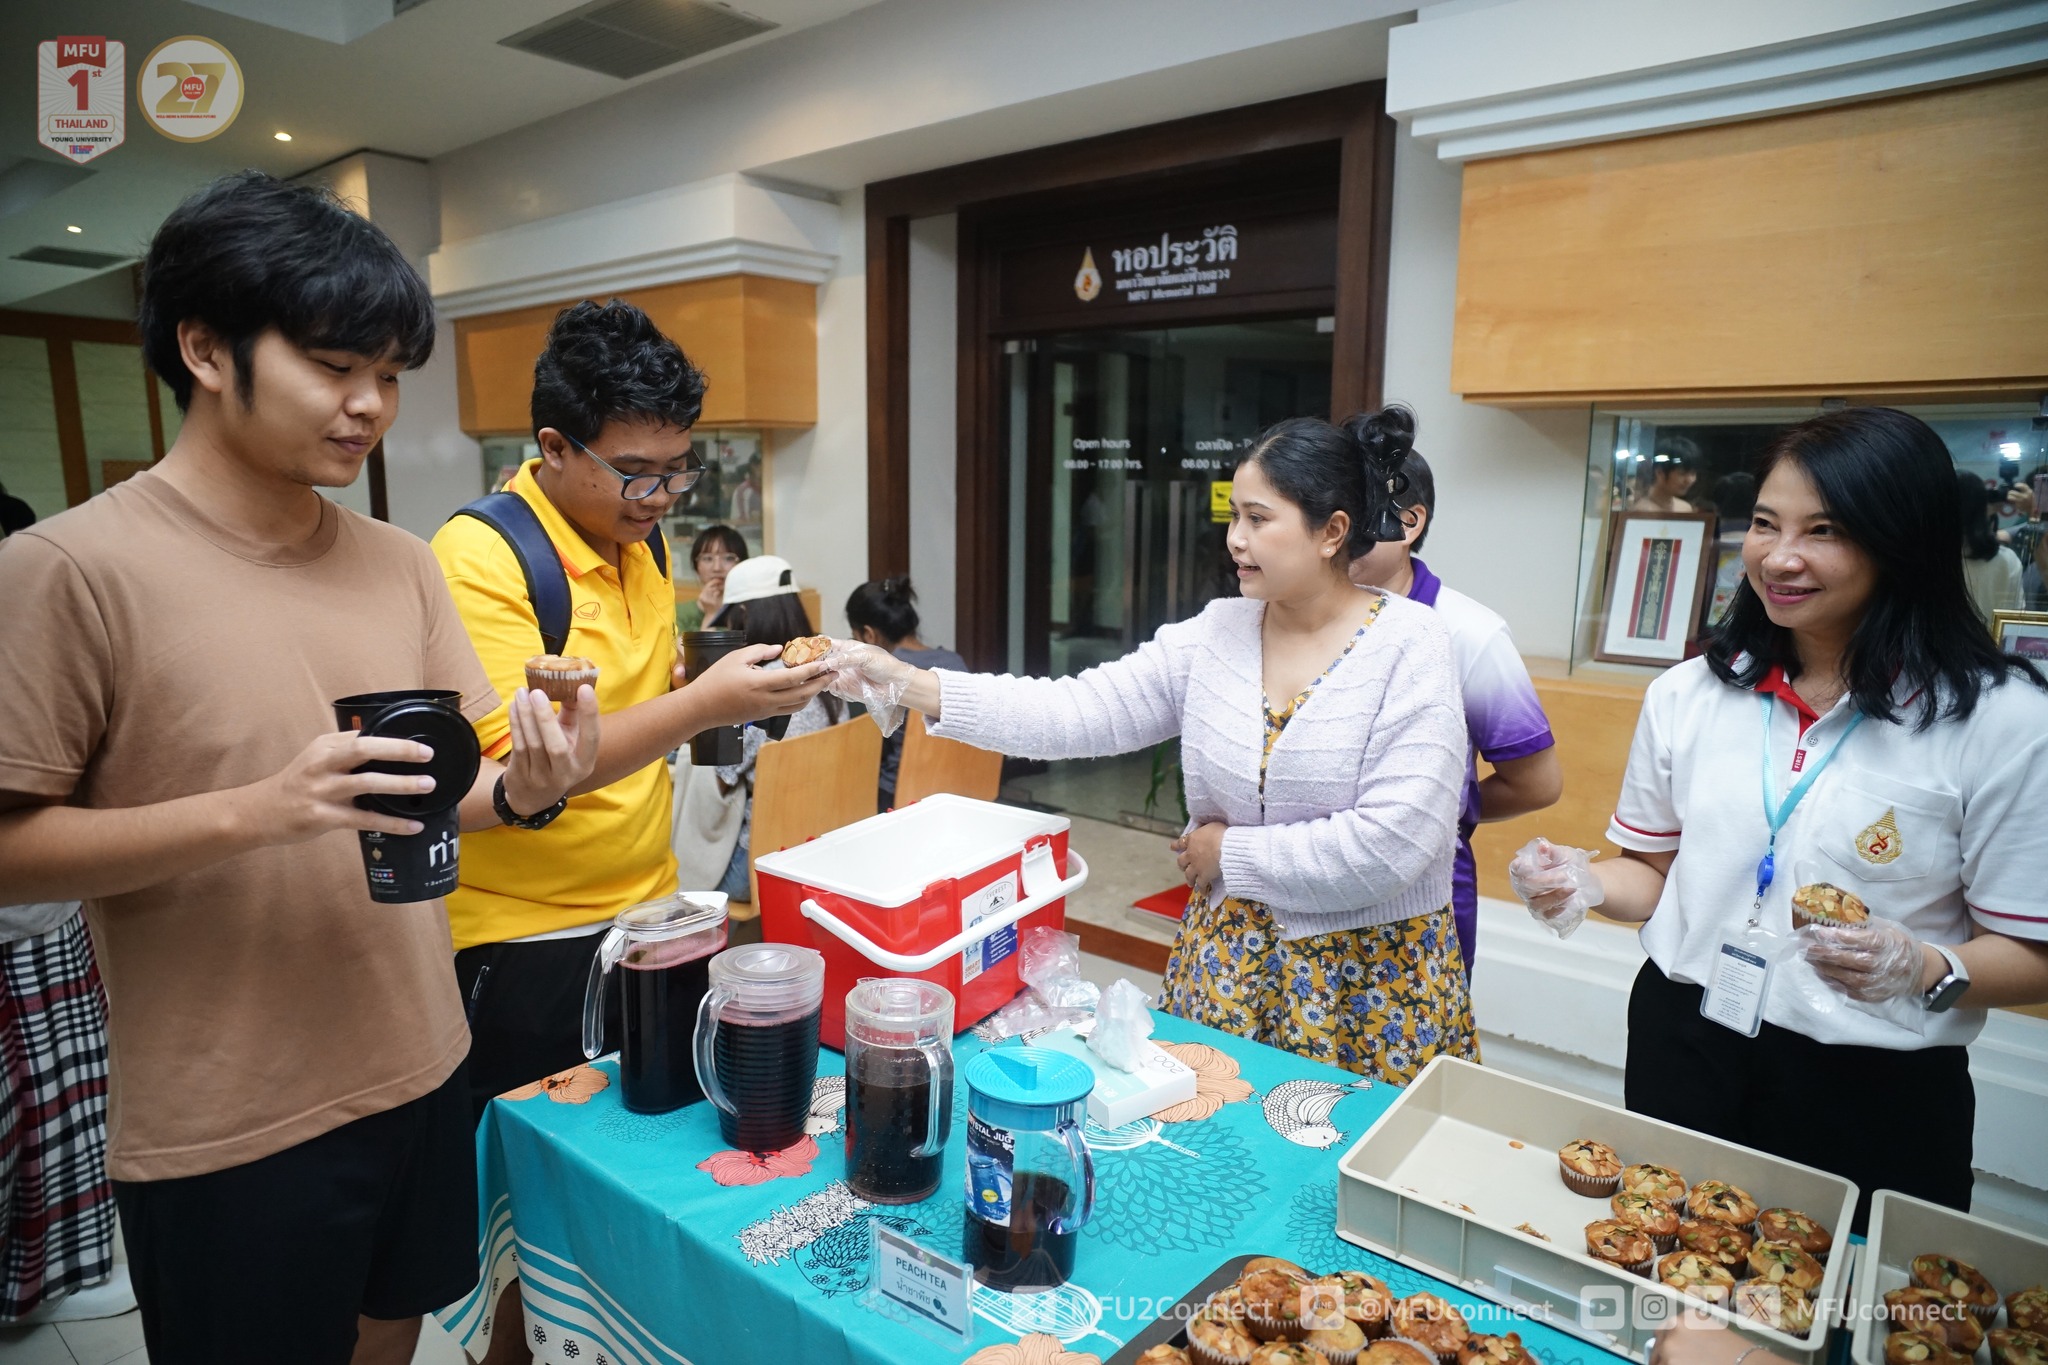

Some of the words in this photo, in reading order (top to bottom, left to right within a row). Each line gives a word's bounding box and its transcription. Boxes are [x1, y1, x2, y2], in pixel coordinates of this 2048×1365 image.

[1112, 224, 1239, 273] หอประวัติ
[1073, 438, 1100, 452] Open
[1101, 437, 1132, 449] hours
[1794, 751, 1804, 770] FIRST
[986, 884, 1007, 899] EVEREST
[993, 1131, 1012, 1144] JUG
[895, 1257, 927, 1281] PEACH
[929, 1273, 947, 1291] TEA
[896, 1277, 931, 1304] น้ำชาพีช
